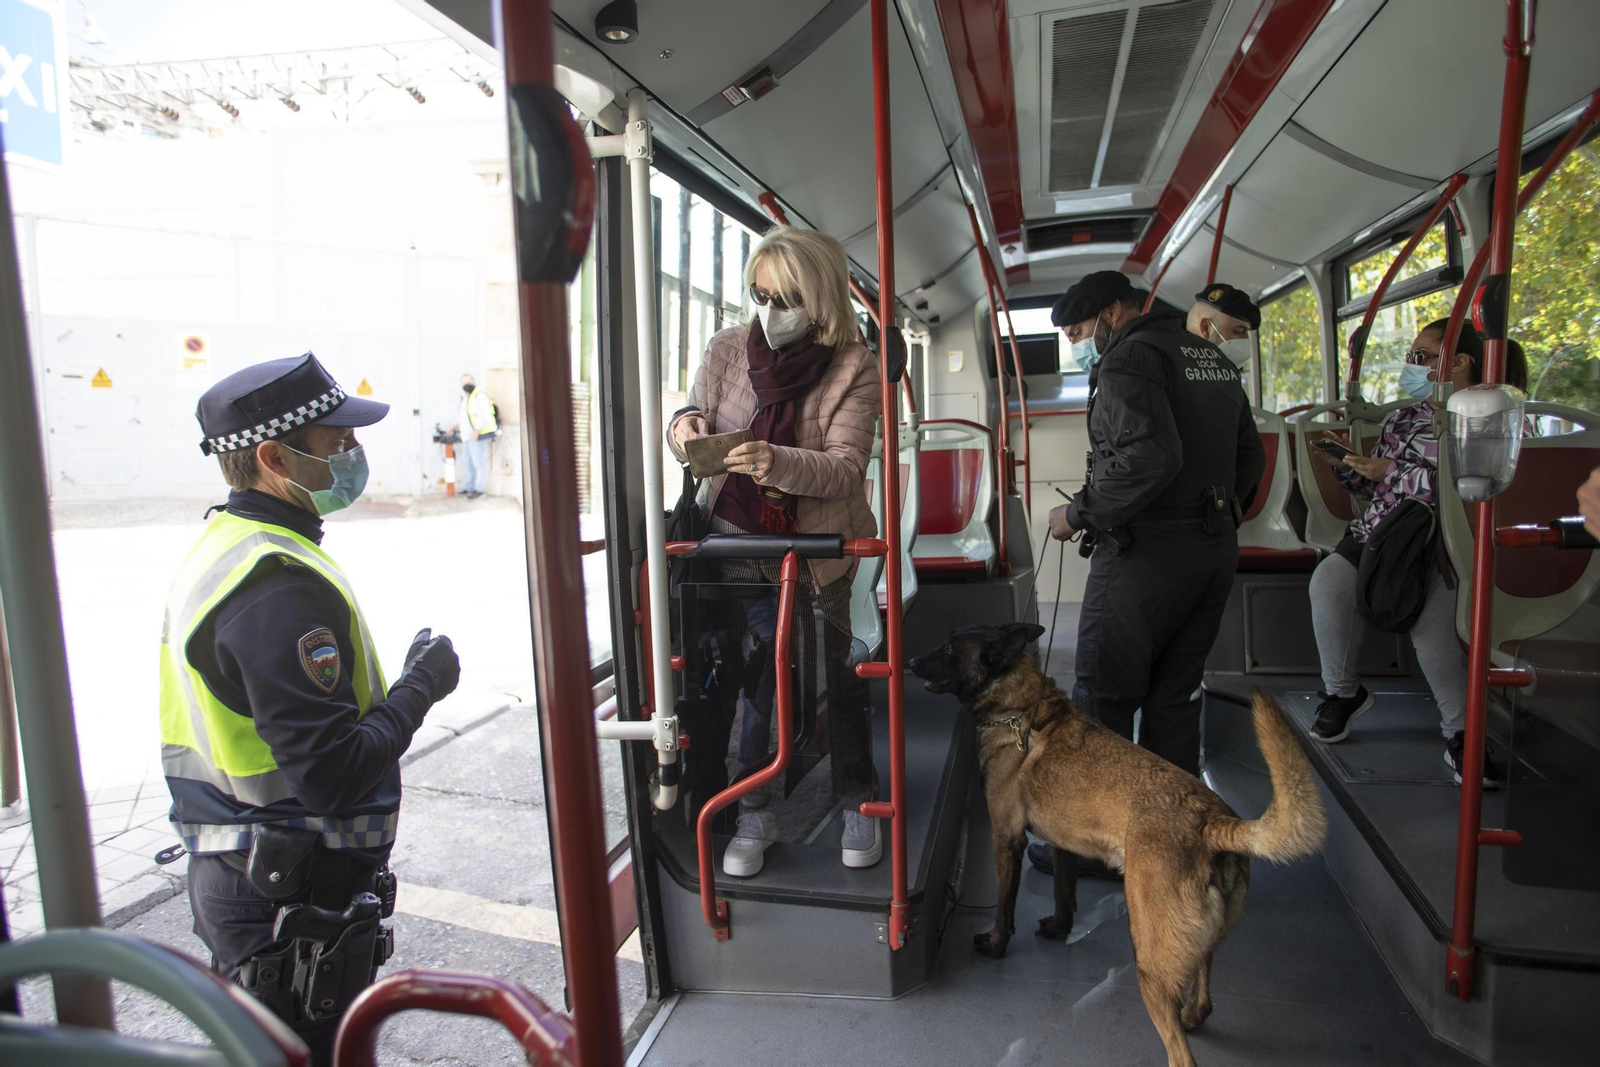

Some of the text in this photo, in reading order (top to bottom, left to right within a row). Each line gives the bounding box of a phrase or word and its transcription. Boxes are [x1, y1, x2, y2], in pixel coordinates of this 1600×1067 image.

[1180, 346, 1221, 360] POLICIA
[1196, 360, 1219, 369] LOCAL
[1185, 367, 1239, 381] GRANADA
